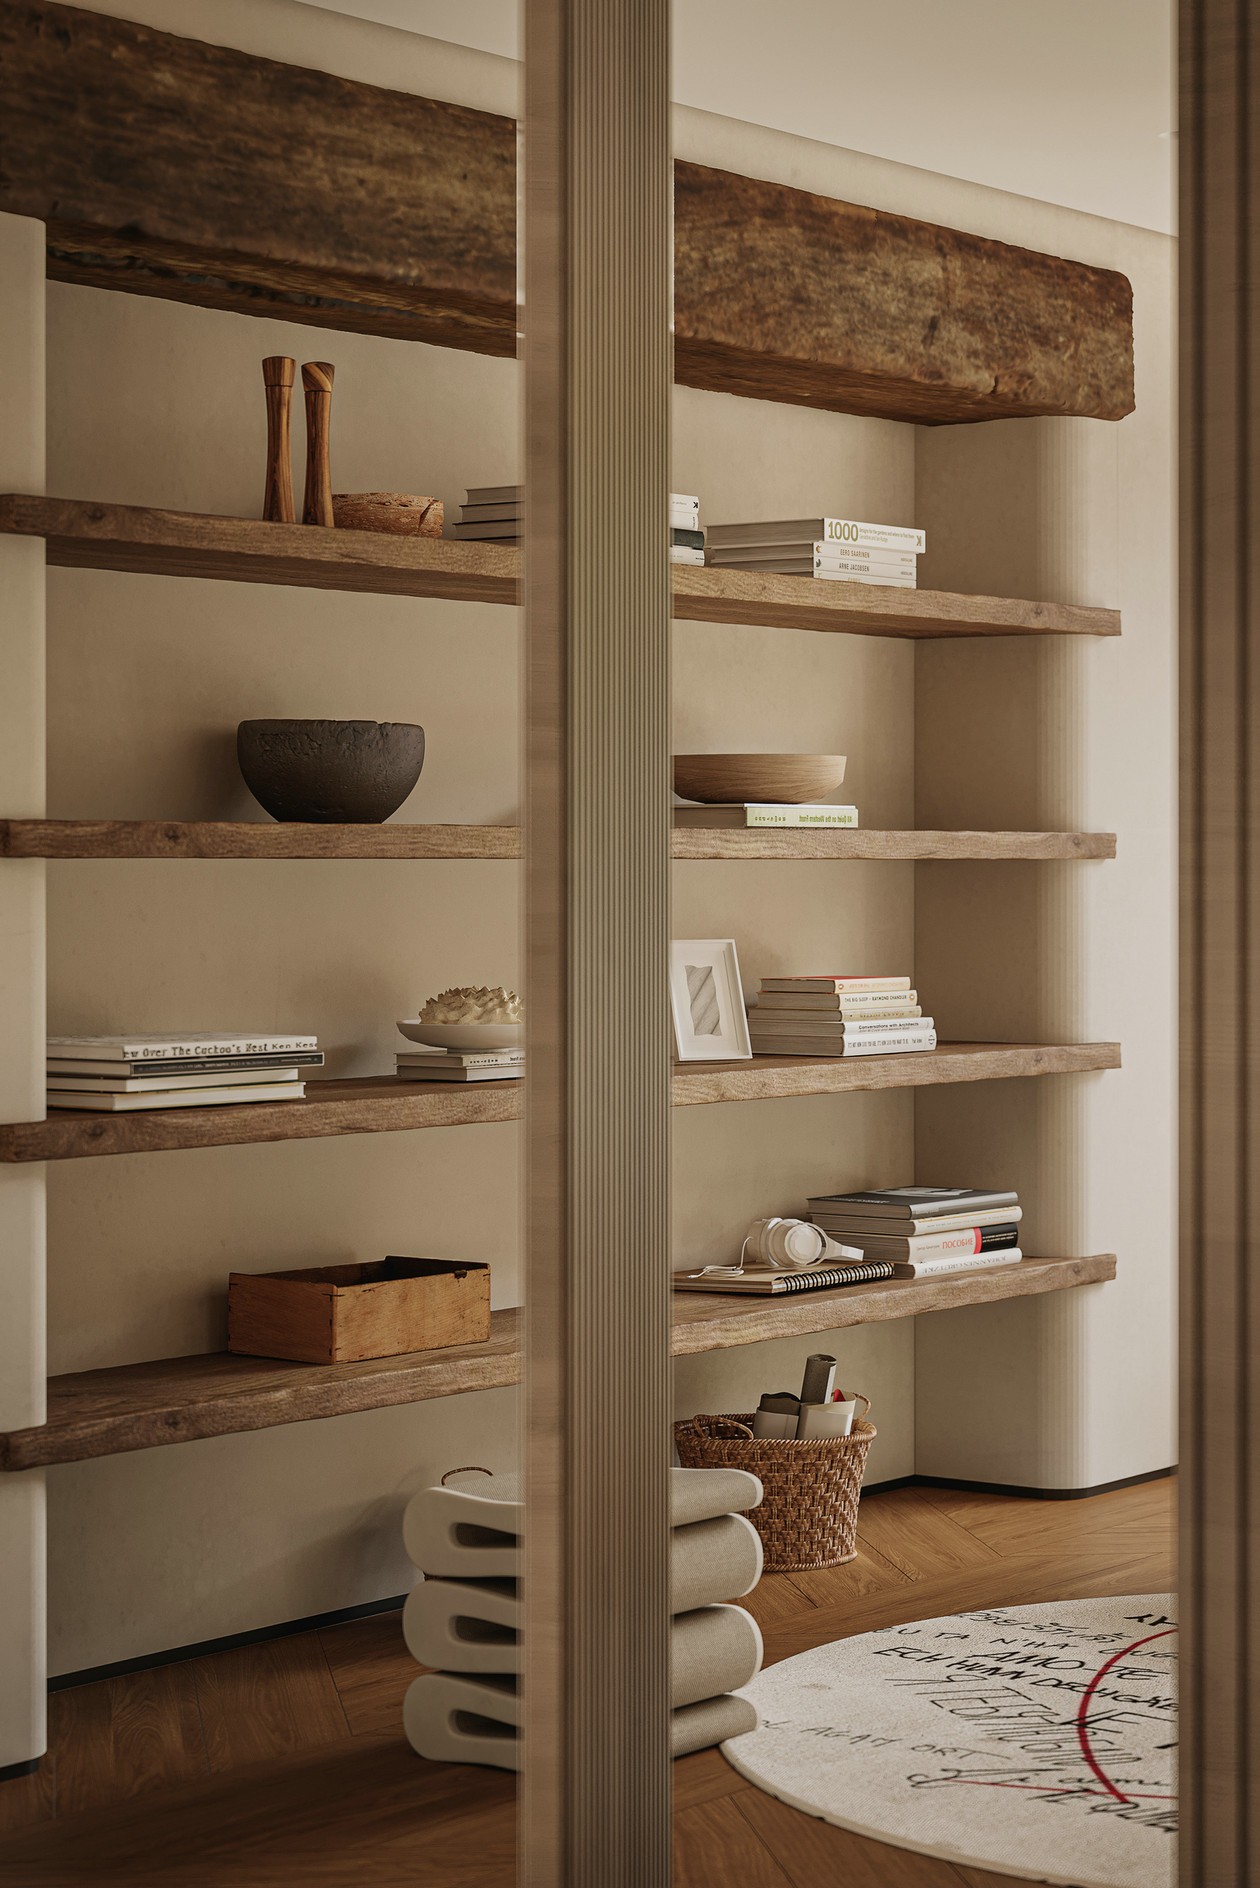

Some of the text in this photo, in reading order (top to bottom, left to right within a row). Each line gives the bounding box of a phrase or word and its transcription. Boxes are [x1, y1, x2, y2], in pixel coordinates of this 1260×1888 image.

[828, 521, 859, 542] 1000
[840, 549, 870, 559] EERO SAARINEN
[850, 563, 870, 573] JACOBSEN
[142, 1048, 167, 1057] Over
[171, 1046, 191, 1056] The
[194, 1044, 241, 1055] Cuckoo's
[245, 1043, 268, 1052] Nest
[942, 1238, 974, 1249] ПОСОБИЕ
[871, 1646, 956, 1663] ECH
[972, 1650, 1169, 1681] AMO-TE
[910, 1744, 1012, 1760] ORT
[1026, 1785, 1114, 1806] TE
